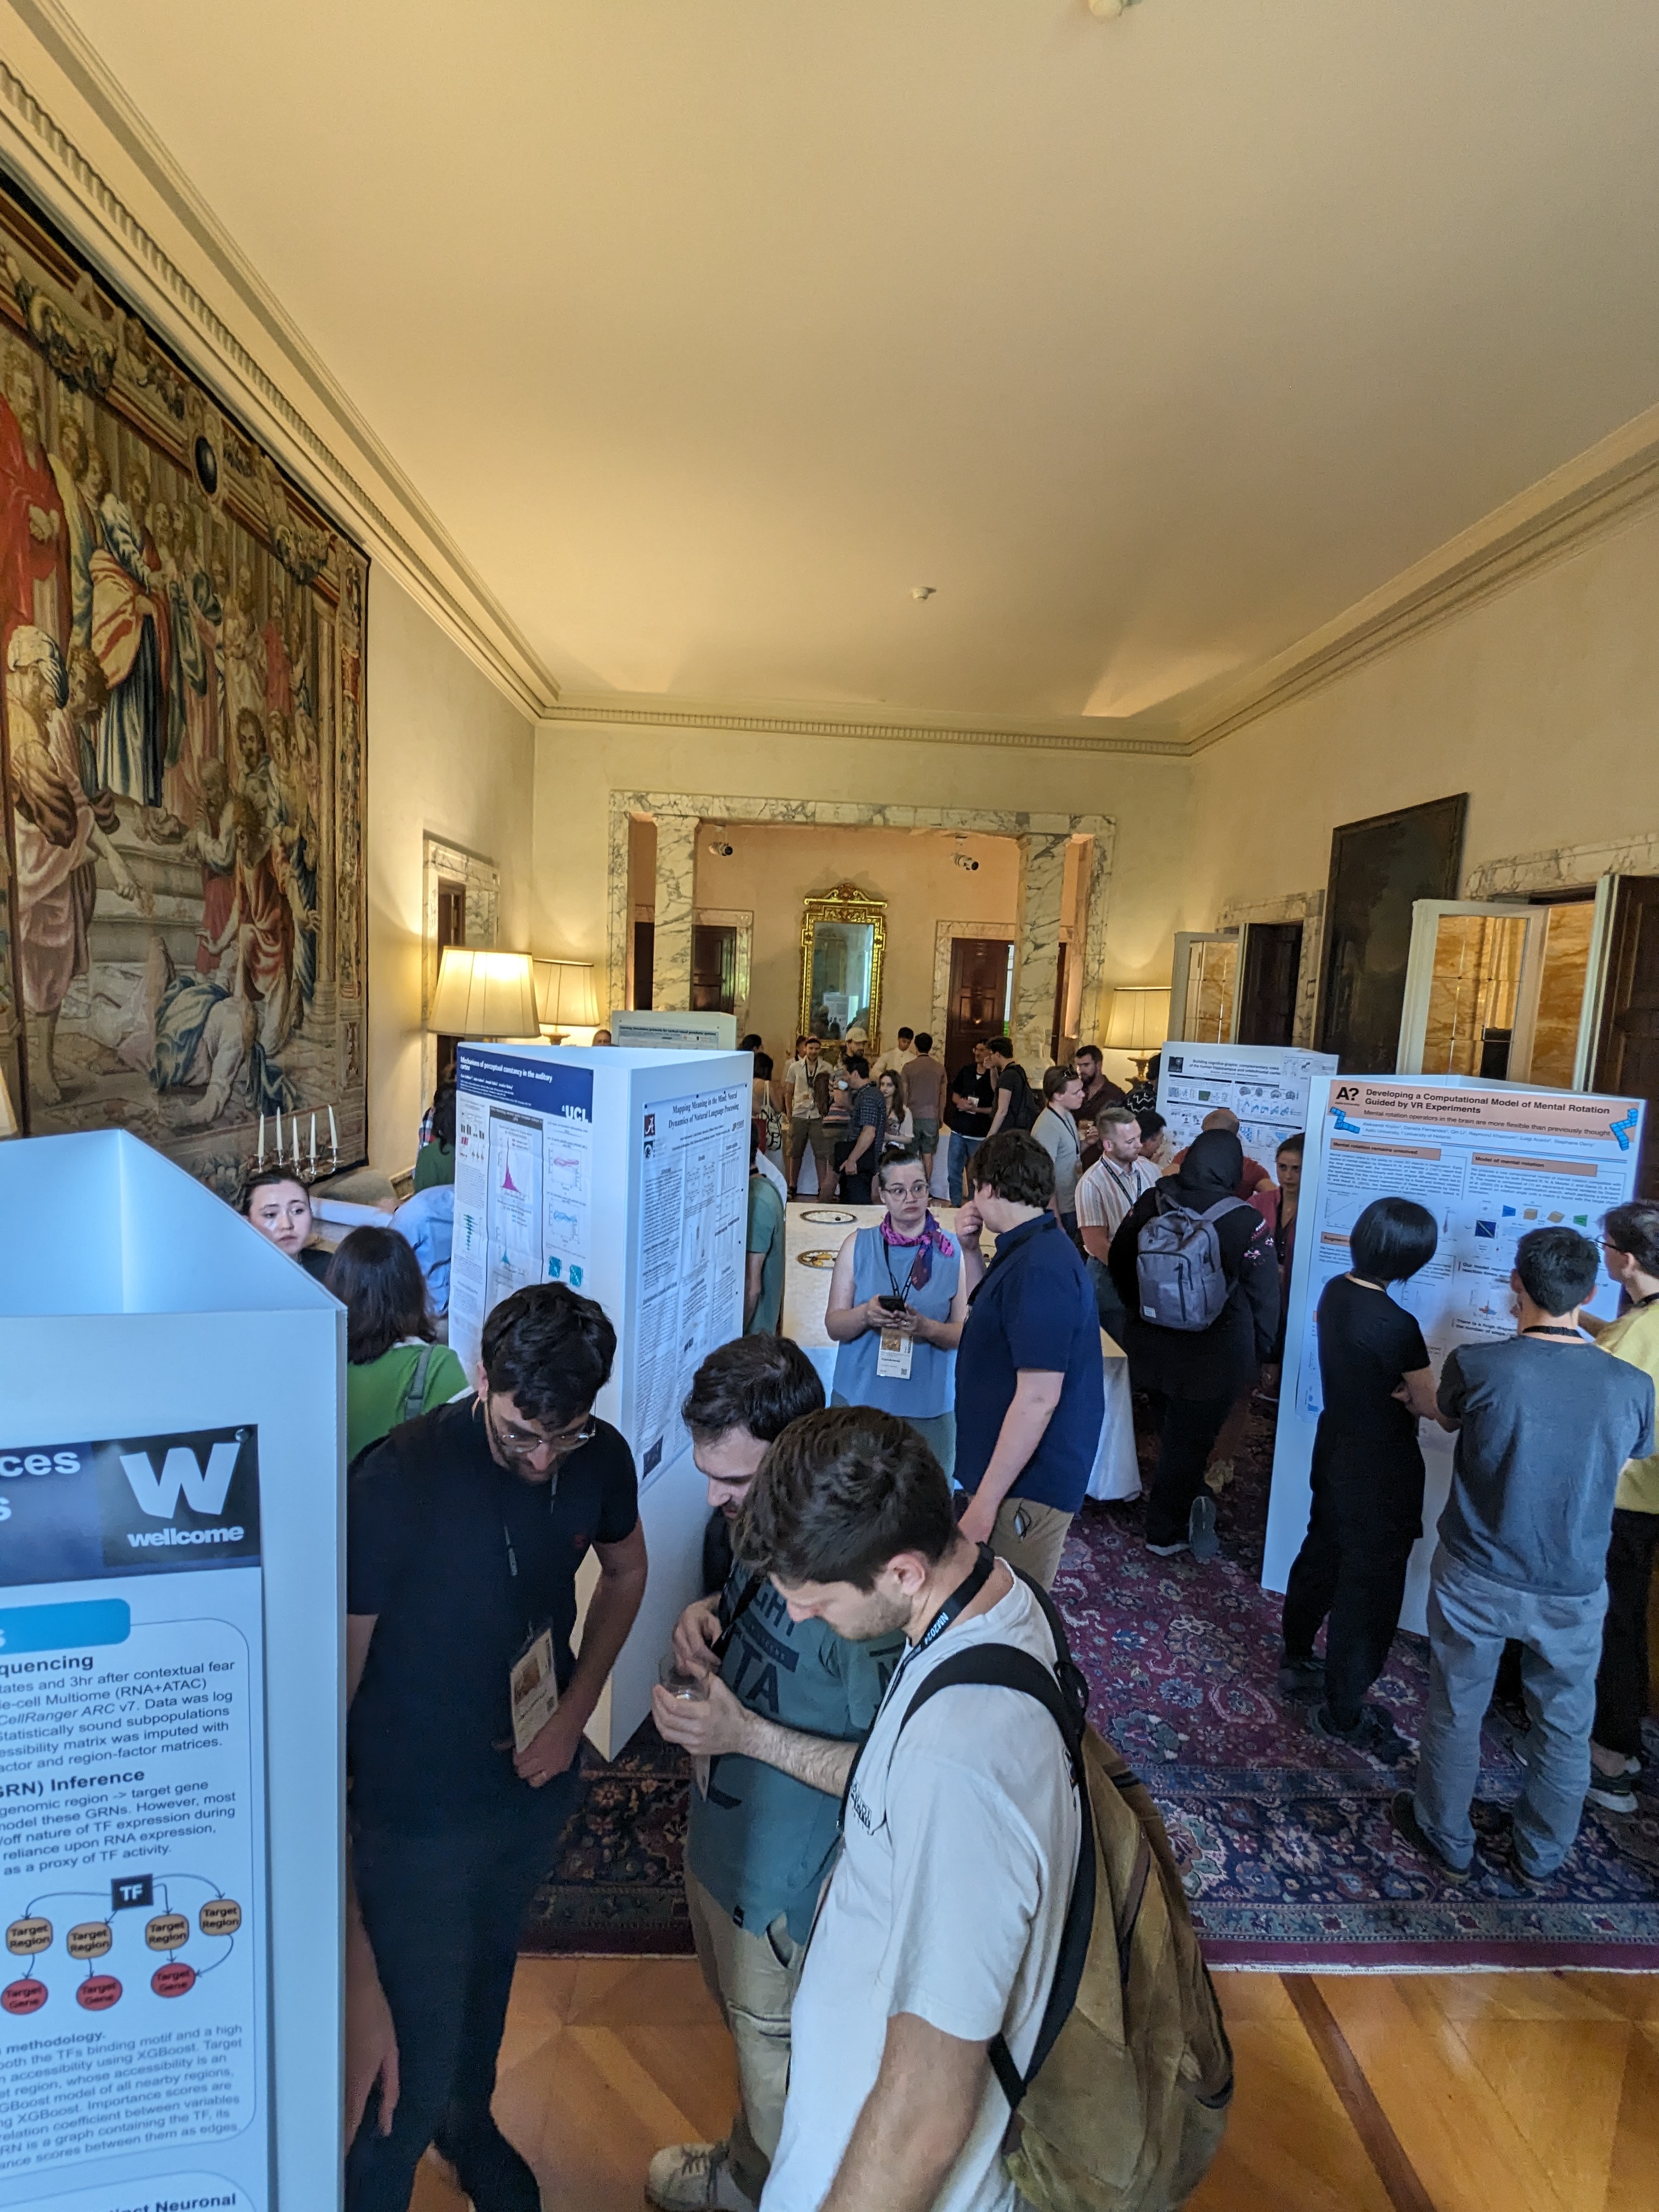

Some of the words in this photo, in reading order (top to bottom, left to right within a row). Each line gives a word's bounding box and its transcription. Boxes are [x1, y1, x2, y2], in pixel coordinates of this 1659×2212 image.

[484, 1062, 503, 1072] perceptual
[504, 1066, 522, 1077] constancy
[535, 1073, 552, 1083] auditory
[673, 1104, 691, 1115] Mapping
[692, 1100, 707, 1110] Meaning
[1365, 1098, 1395, 1107] Guided
[1398, 1099, 1408, 1109] by
[1426, 1103, 1481, 1114] Experiments
[1366, 1089, 1414, 1100] Developing
[1423, 1093, 1488, 1105] Computational
[1491, 1098, 1519, 1107] Model
[1534, 1102, 1566, 1111] Mental
[1568, 1104, 1610, 1114] Rotation
[565, 1105, 588, 1122] UCL
[669, 1117, 689, 1130] Dynamics
[694, 1110, 708, 1121] Natural
[708, 1107, 724, 1118] Language
[1409, 1114, 1438, 1122] operators
[1548, 1126, 1582, 1135] previously
[0, 1451, 81, 1477] ces
[127, 1526, 244, 1548] wellcome
[0, 1656, 93, 1678] quencing
[39, 1678, 65, 1690] and
[70, 1677, 93, 1687] 3hr
[98, 1672, 129, 1684] after
[134, 1663, 204, 1680] contextual
[209, 1661, 235, 1672] fear
[46, 1691, 110, 1706] Multiome
[116, 1678, 206, 1700] (RNA+ATAC)
[81, 1703, 115, 1717] ARC
[120, 1701, 139, 1712] v7.
[145, 1697, 177, 1709] Data
[182, 1694, 209, 1705] was
[213, 1691, 233, 1703] log
[79, 1718, 122, 1733] sound
[127, 1708, 230, 1726] subpopulations
[64, 1736, 106, 1750] matrix
[111, 1733, 139, 1744] was
[144, 1724, 198, 1740] imputed
[202, 1722, 229, 1733] with
[37, 1756, 64, 1769] and
[69, 1746, 157, 1765] region-factor
[161, 1737, 222, 1753] matrices.
[50, 1770, 145, 1792] Inference
[0, 1799, 60, 1818] genomic
[65, 1794, 108, 1808] region
[132, 1785, 171, 1798] target
[174, 1781, 208, 1796] gene
[42, 1813, 80, 1825] these
[137, 1798, 199, 1813] However,
[204, 1792, 236, 1804] most
[26, 1829, 71, 1842] nature
[76, 1824, 89, 1835] of
[94, 1821, 111, 1832] TF
[116, 1813, 190, 1830] expression
[194, 1808, 235, 1819] during
[3, 1844, 60, 1861] reliance
[65, 1839, 99, 1852] upon
[104, 1832, 136, 1846] RNA
[140, 1825, 216, 1841] expression,
[4, 1865, 21, 1876] as
[26, 1864, 34, 1872] a
[40, 1858, 78, 1873] proxy
[83, 1852, 96, 1864] of
[99, 1848, 118, 1862] TF
[123, 1844, 172, 1858] activity.
[119, 1883, 143, 1902] TF
[204, 1906, 238, 1917] Target
[12, 1924, 48, 1937] Target
[150, 1921, 185, 1933] Target
[202, 1918, 240, 1929] Region
[9, 1936, 50, 1949] Region
[71, 1940, 110, 1953] Region
[72, 1929, 108, 1942] Target
[149, 1932, 187, 1945] Region
[6, 2032, 106, 2055] methodology.
[31, 2053, 53, 2064] the
[87, 2040, 136, 2055] binding
[176, 2028, 201, 2041] and
[204, 2028, 212, 2036] a
[216, 2024, 242, 2036] high
[10, 2060, 93, 2083] accessibility
[204, 2038, 242, 2050] Target
[66, 2072, 110, 2086] whose
[114, 2058, 193, 2078] accessibility
[136, 2074, 181, 2089] nearby
[88, 2090, 161, 2110] Importance
[166, 2085, 208, 2097] scores
[125, 2102, 180, 2118] between
[184, 2095, 240, 2108] variables
[55, 2129, 94, 2146] graph
[98, 2117, 166, 2135] containing
[156, 2193, 236, 2212] Neuronal
